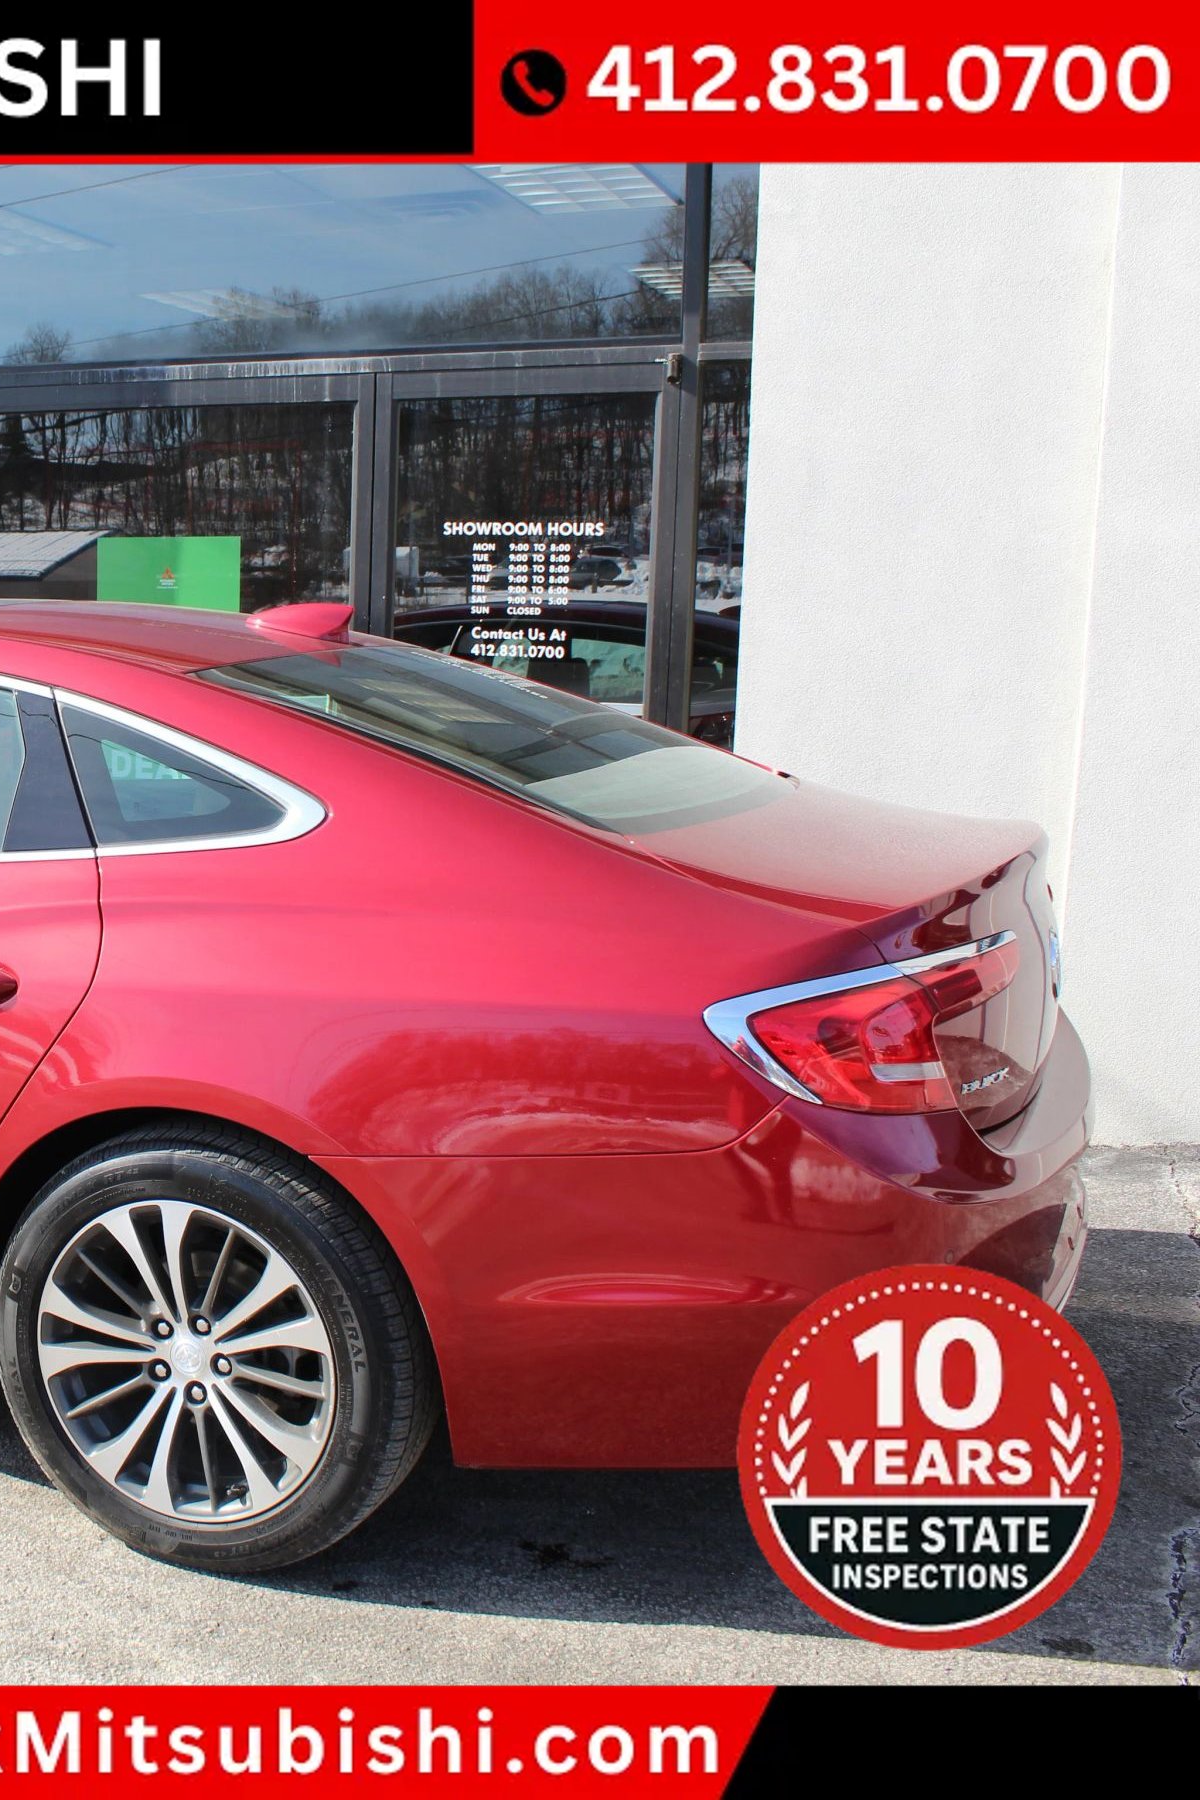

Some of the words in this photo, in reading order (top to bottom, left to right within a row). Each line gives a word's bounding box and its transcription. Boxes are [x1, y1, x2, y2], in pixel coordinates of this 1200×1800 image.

[443, 521, 543, 536] SHOWROOM
[547, 522, 605, 537] HOURS
[472, 543, 496, 552] MON
[509, 543, 530, 552] 9:00
[533, 544, 546, 552] TO
[550, 544, 571, 552] 8:00
[472, 553, 489, 562] TUE
[508, 554, 529, 562] 9:00
[532, 554, 545, 562] TO
[549, 554, 571, 563] 8:00
[472, 564, 492, 572] WED
[508, 564, 528, 573] 9:00
[532, 564, 545, 573] TO
[549, 565, 570, 573] 8:00
[471, 575, 490, 583] THU
[507, 575, 528, 584] 9:00
[532, 576, 545, 584] TO
[548, 576, 570, 584] 8:00
[471, 585, 486, 593] FRI
[507, 586, 528, 594] 9:00
[531, 586, 544, 594] TO
[470, 595, 487, 604] SAT
[507, 596, 526, 605] 9:00
[530, 596, 543, 605] TO
[470, 606, 490, 615] SUN
[506, 606, 542, 616] CLOSED
[471, 626, 524, 641] Contact
[528, 628, 546, 641] Us
[549, 628, 567, 642] At
[470, 643, 565, 659] 412.831.0700
[111, 749, 191, 780] DEA
[961, 1066, 1010, 1095] BUICK
